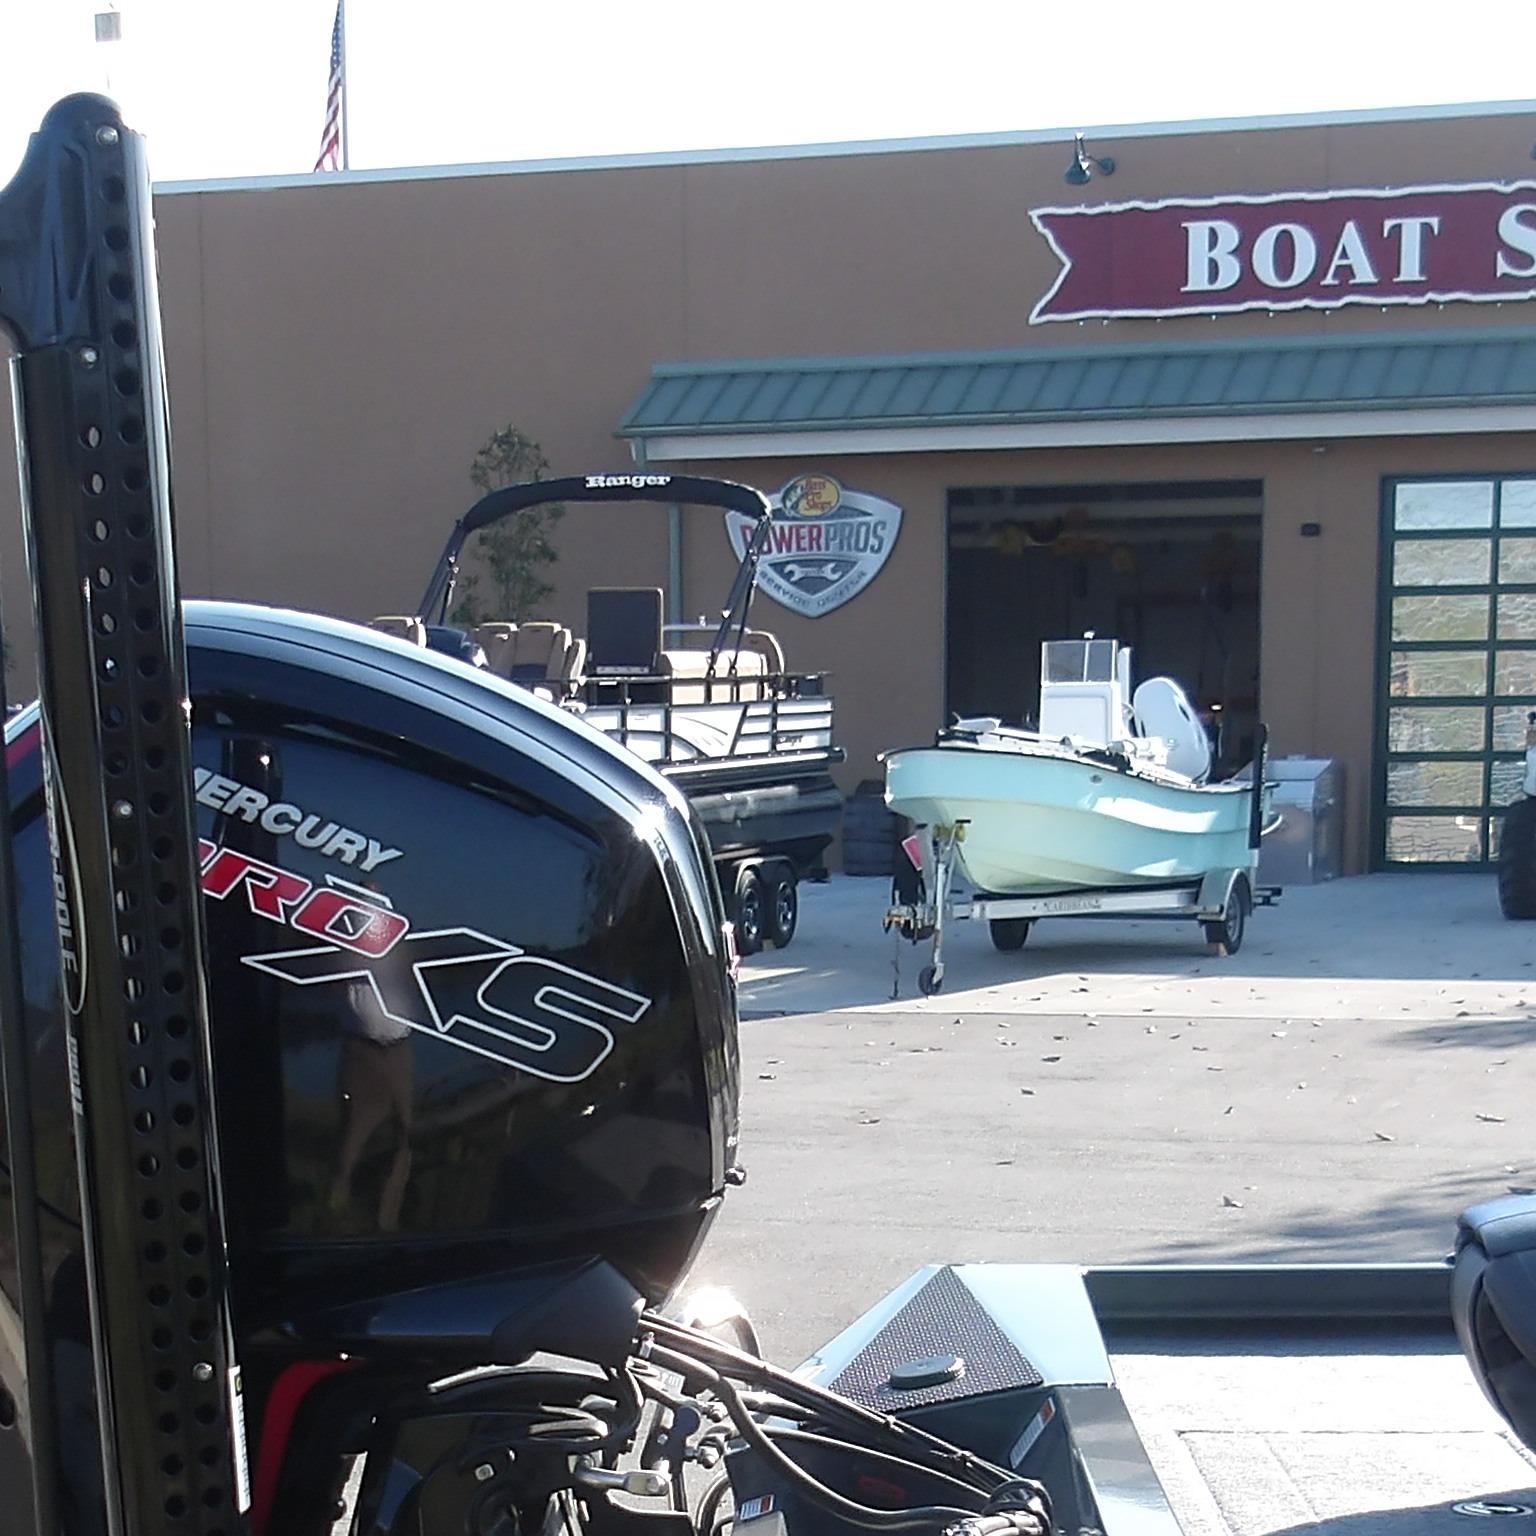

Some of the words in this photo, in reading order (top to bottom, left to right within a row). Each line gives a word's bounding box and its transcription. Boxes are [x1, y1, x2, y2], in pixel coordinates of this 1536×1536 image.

[1179, 217, 1441, 292] BOAT
[585, 475, 671, 489] Ranger
[198, 837, 410, 959] RO
[239, 873, 652, 1083] XS
